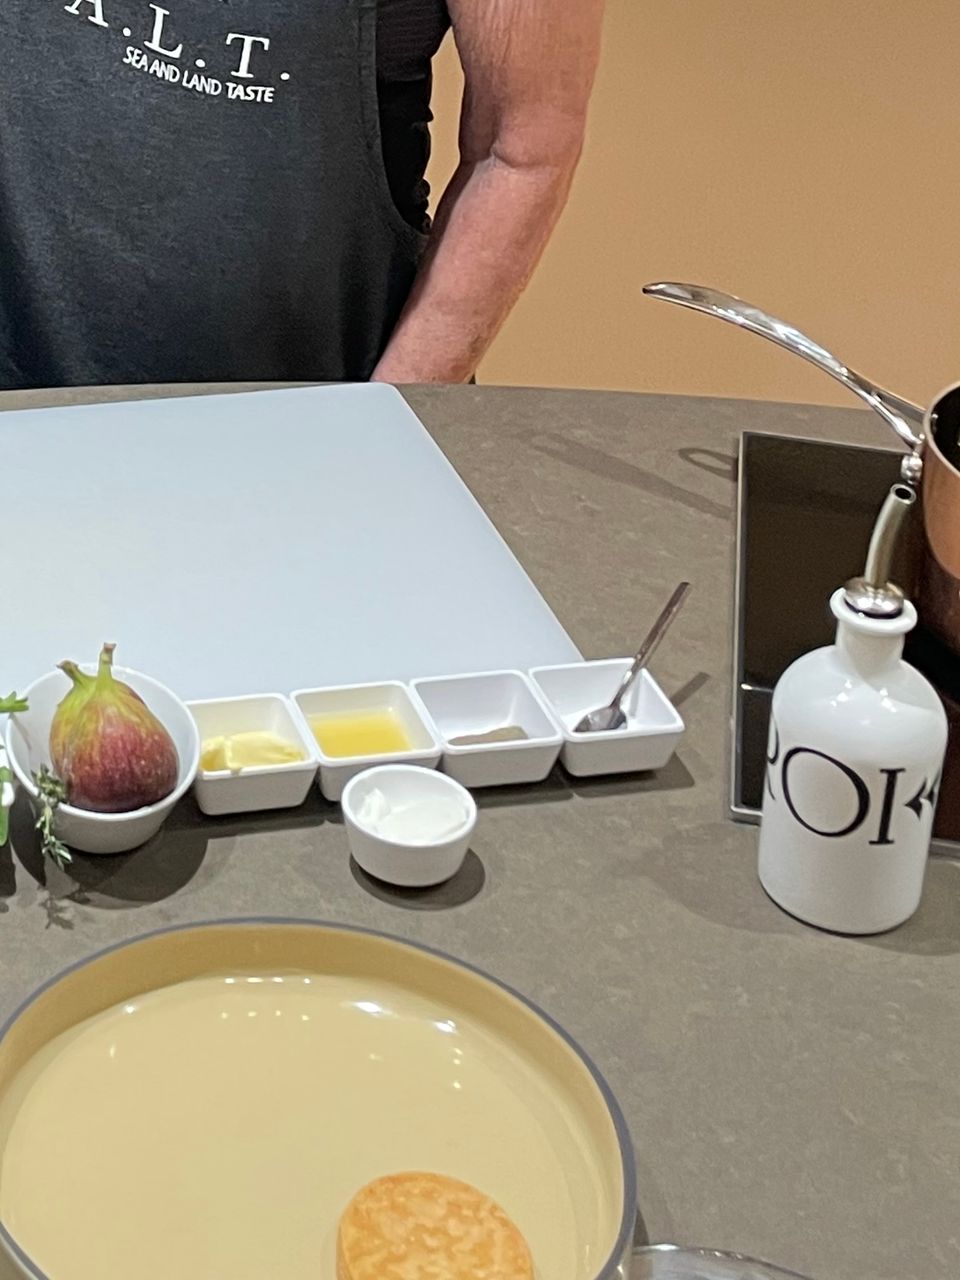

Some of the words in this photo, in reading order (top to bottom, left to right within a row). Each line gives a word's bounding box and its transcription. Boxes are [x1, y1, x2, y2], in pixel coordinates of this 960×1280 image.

[123, 46, 148, 73] SEA
[149, 58, 180, 84] AND
[182, 69, 222, 97] LAND
[225, 82, 275, 103] TASTE
